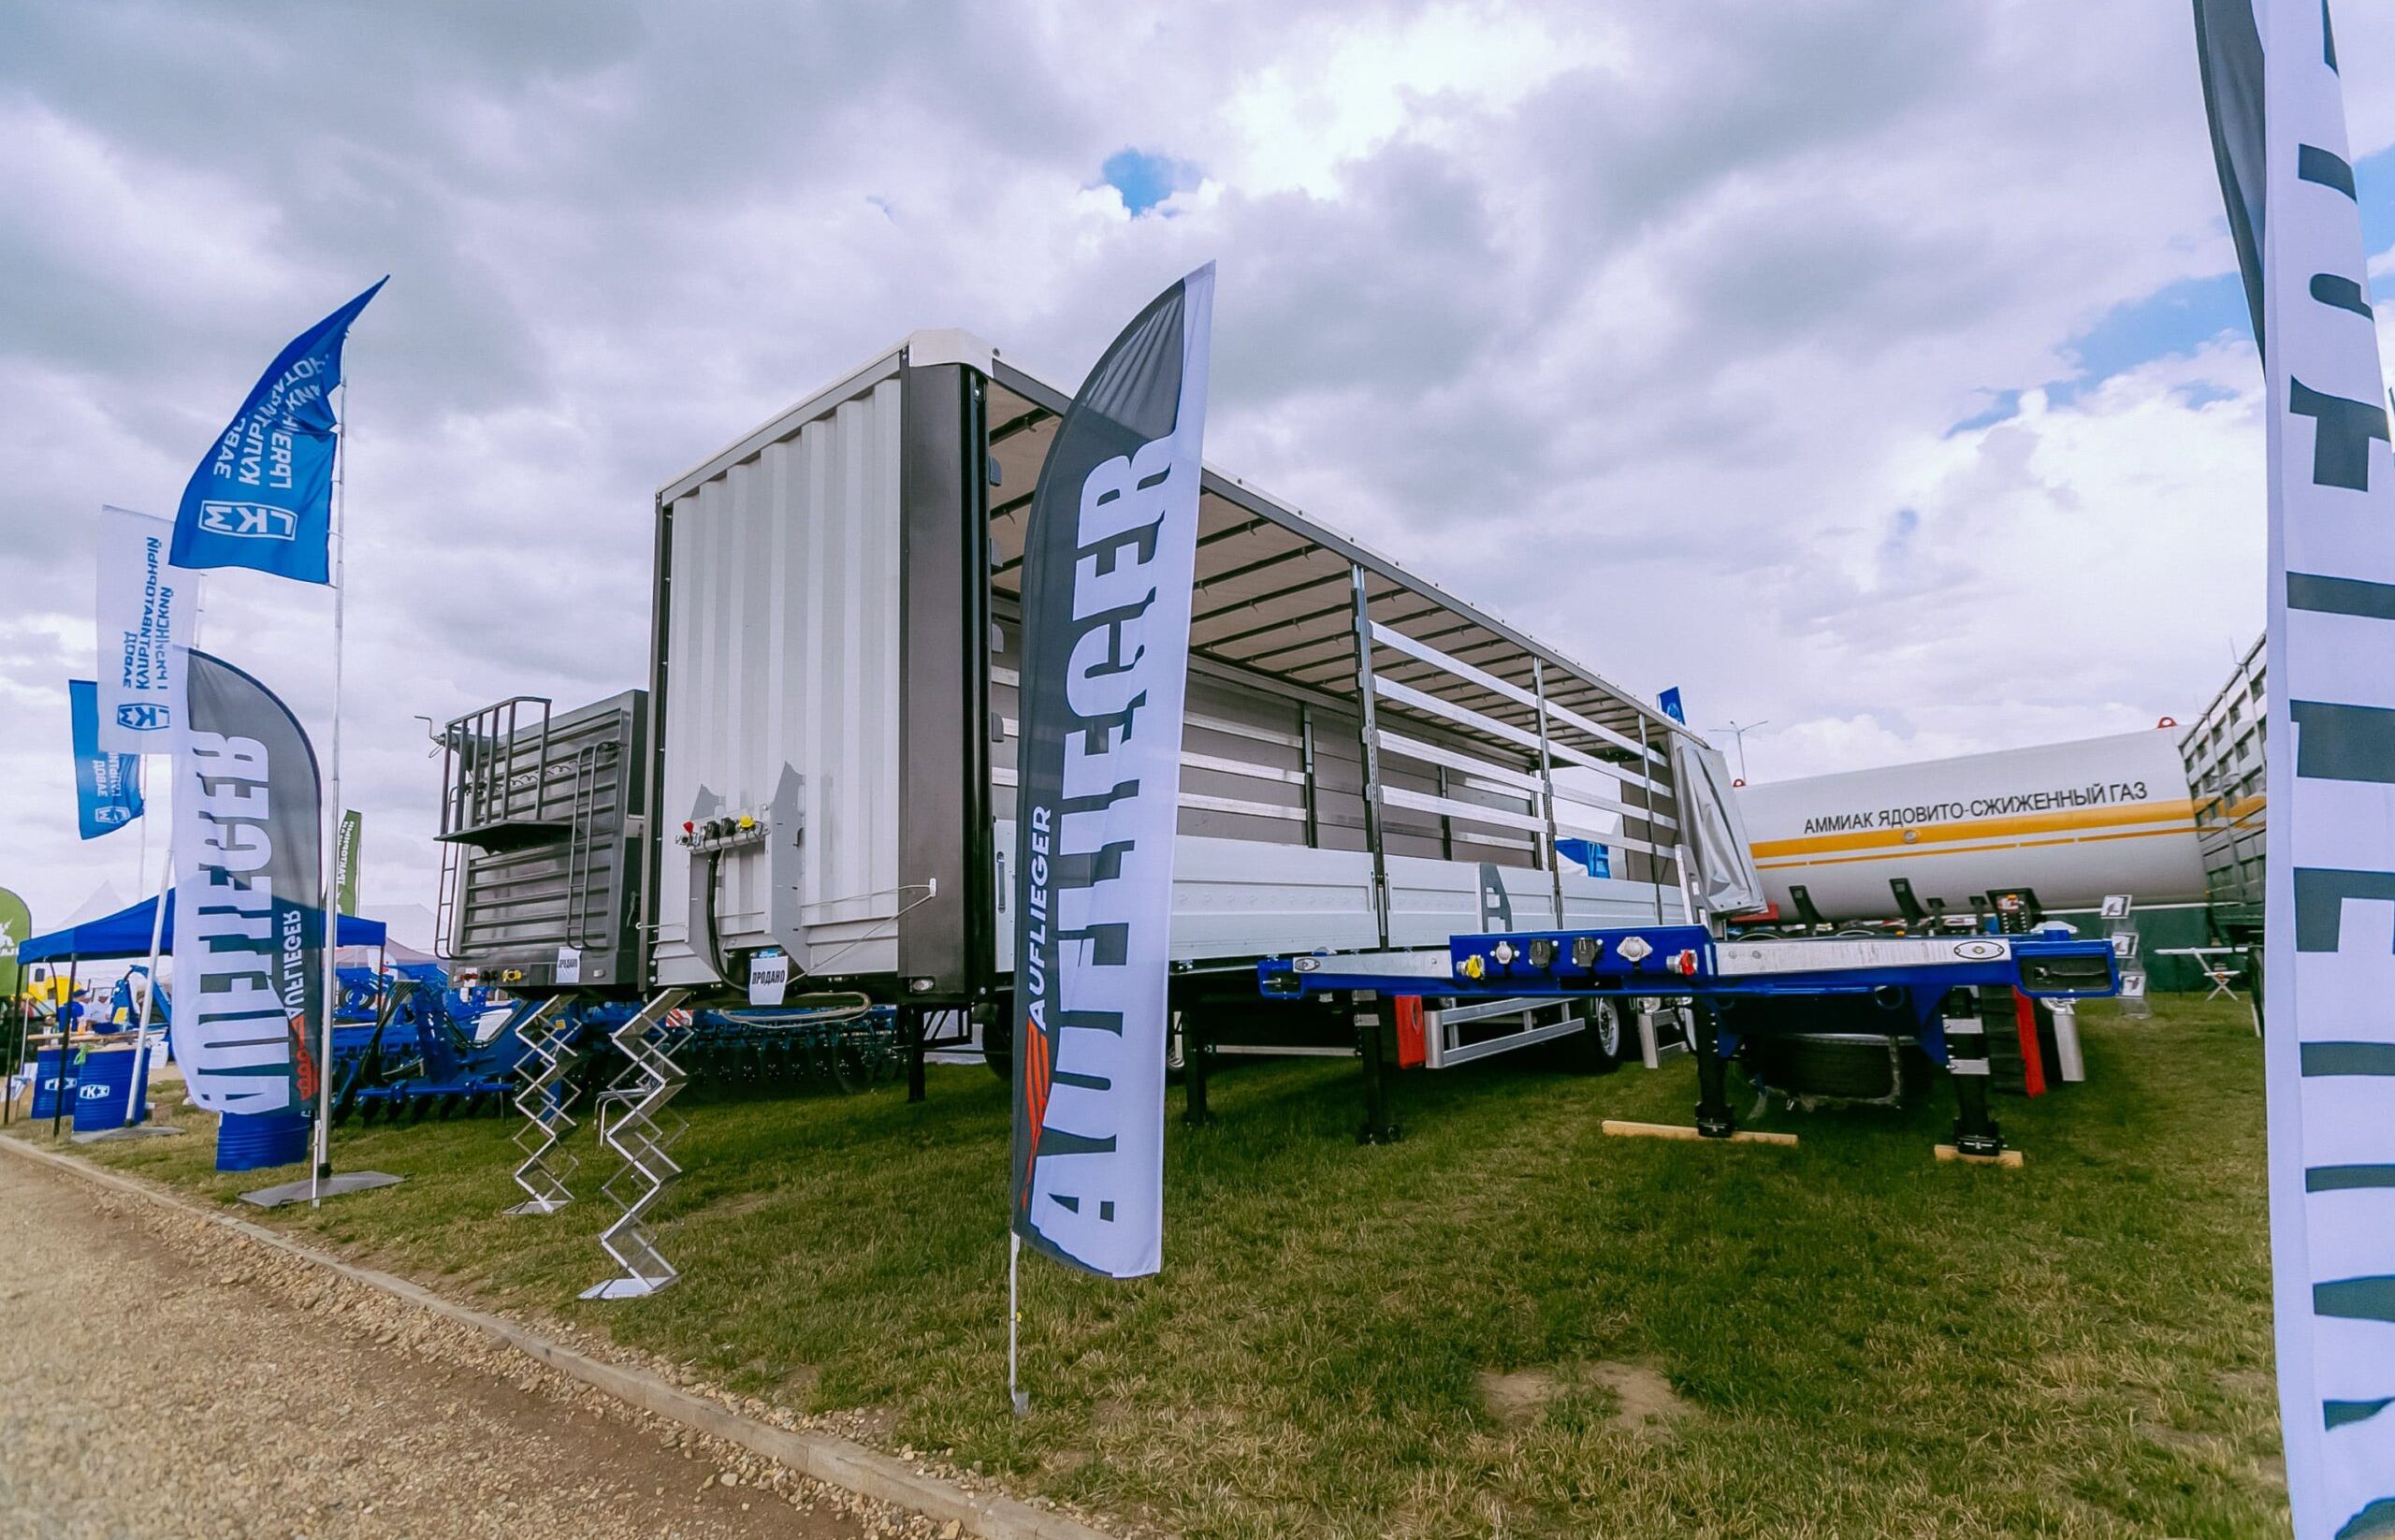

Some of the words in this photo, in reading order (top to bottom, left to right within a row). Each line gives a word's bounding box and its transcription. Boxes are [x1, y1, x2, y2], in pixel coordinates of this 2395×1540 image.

[1030, 433, 1174, 1273] AUFLIEGER
[1804, 811, 1874, 835] АММИАК
[1879, 782, 2107, 828] ЯДОВИТО-СЖИЖЕННЫЙ
[2111, 781, 2148, 802] ГАЗ
[751, 969, 785, 986] ПРОДАНО
[1026, 805, 1052, 1031] AUFLIEGER
